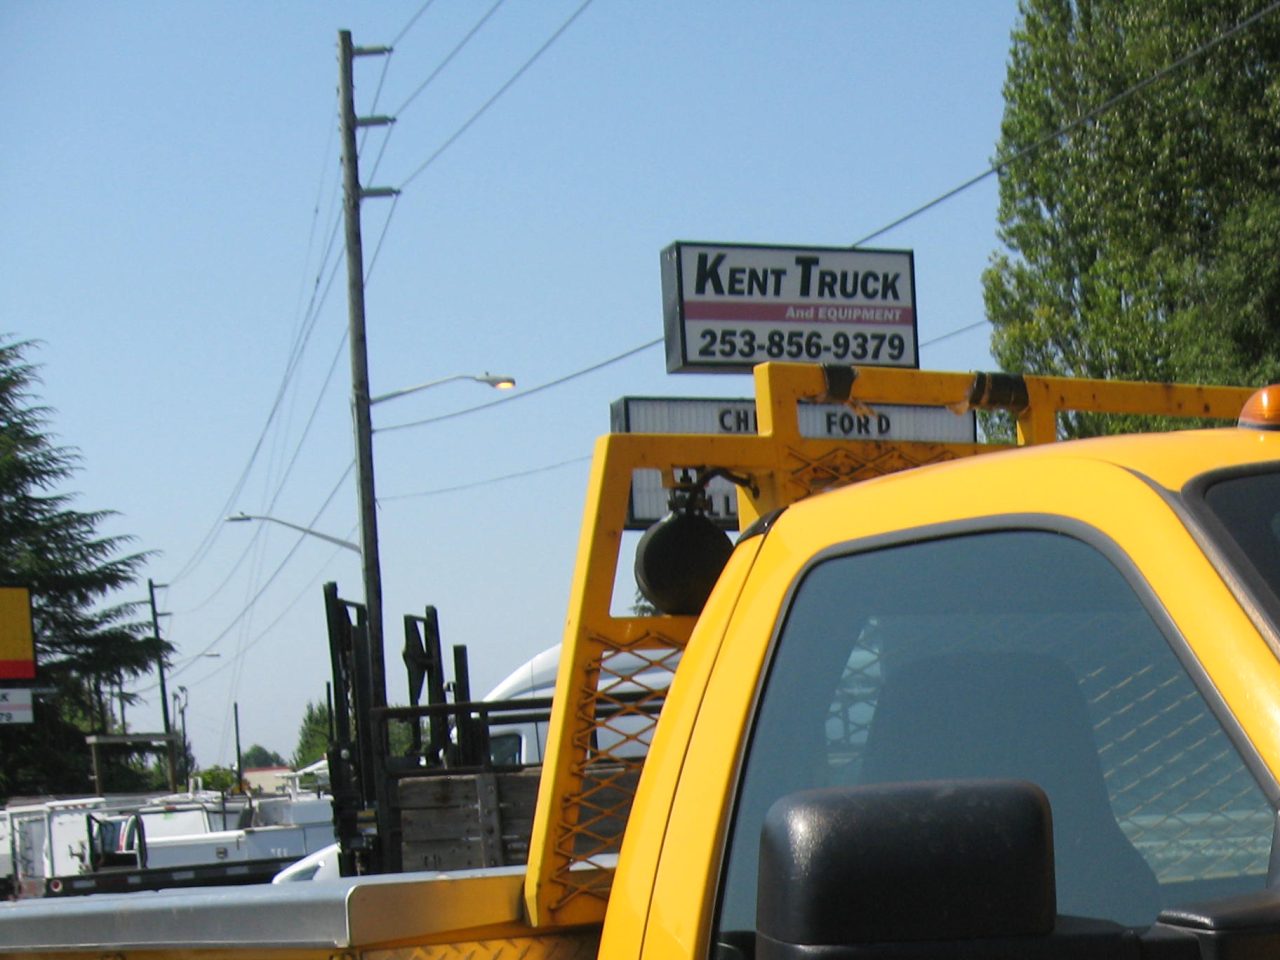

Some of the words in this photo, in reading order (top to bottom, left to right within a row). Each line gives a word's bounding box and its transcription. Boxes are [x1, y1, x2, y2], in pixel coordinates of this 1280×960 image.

[695, 252, 787, 297] KENT
[795, 255, 901, 301] TRUCK
[785, 306, 814, 320] And
[818, 306, 902, 322] EQUIPMENT
[698, 328, 905, 361] 253-856-9379
[825, 411, 891, 436] FORD
